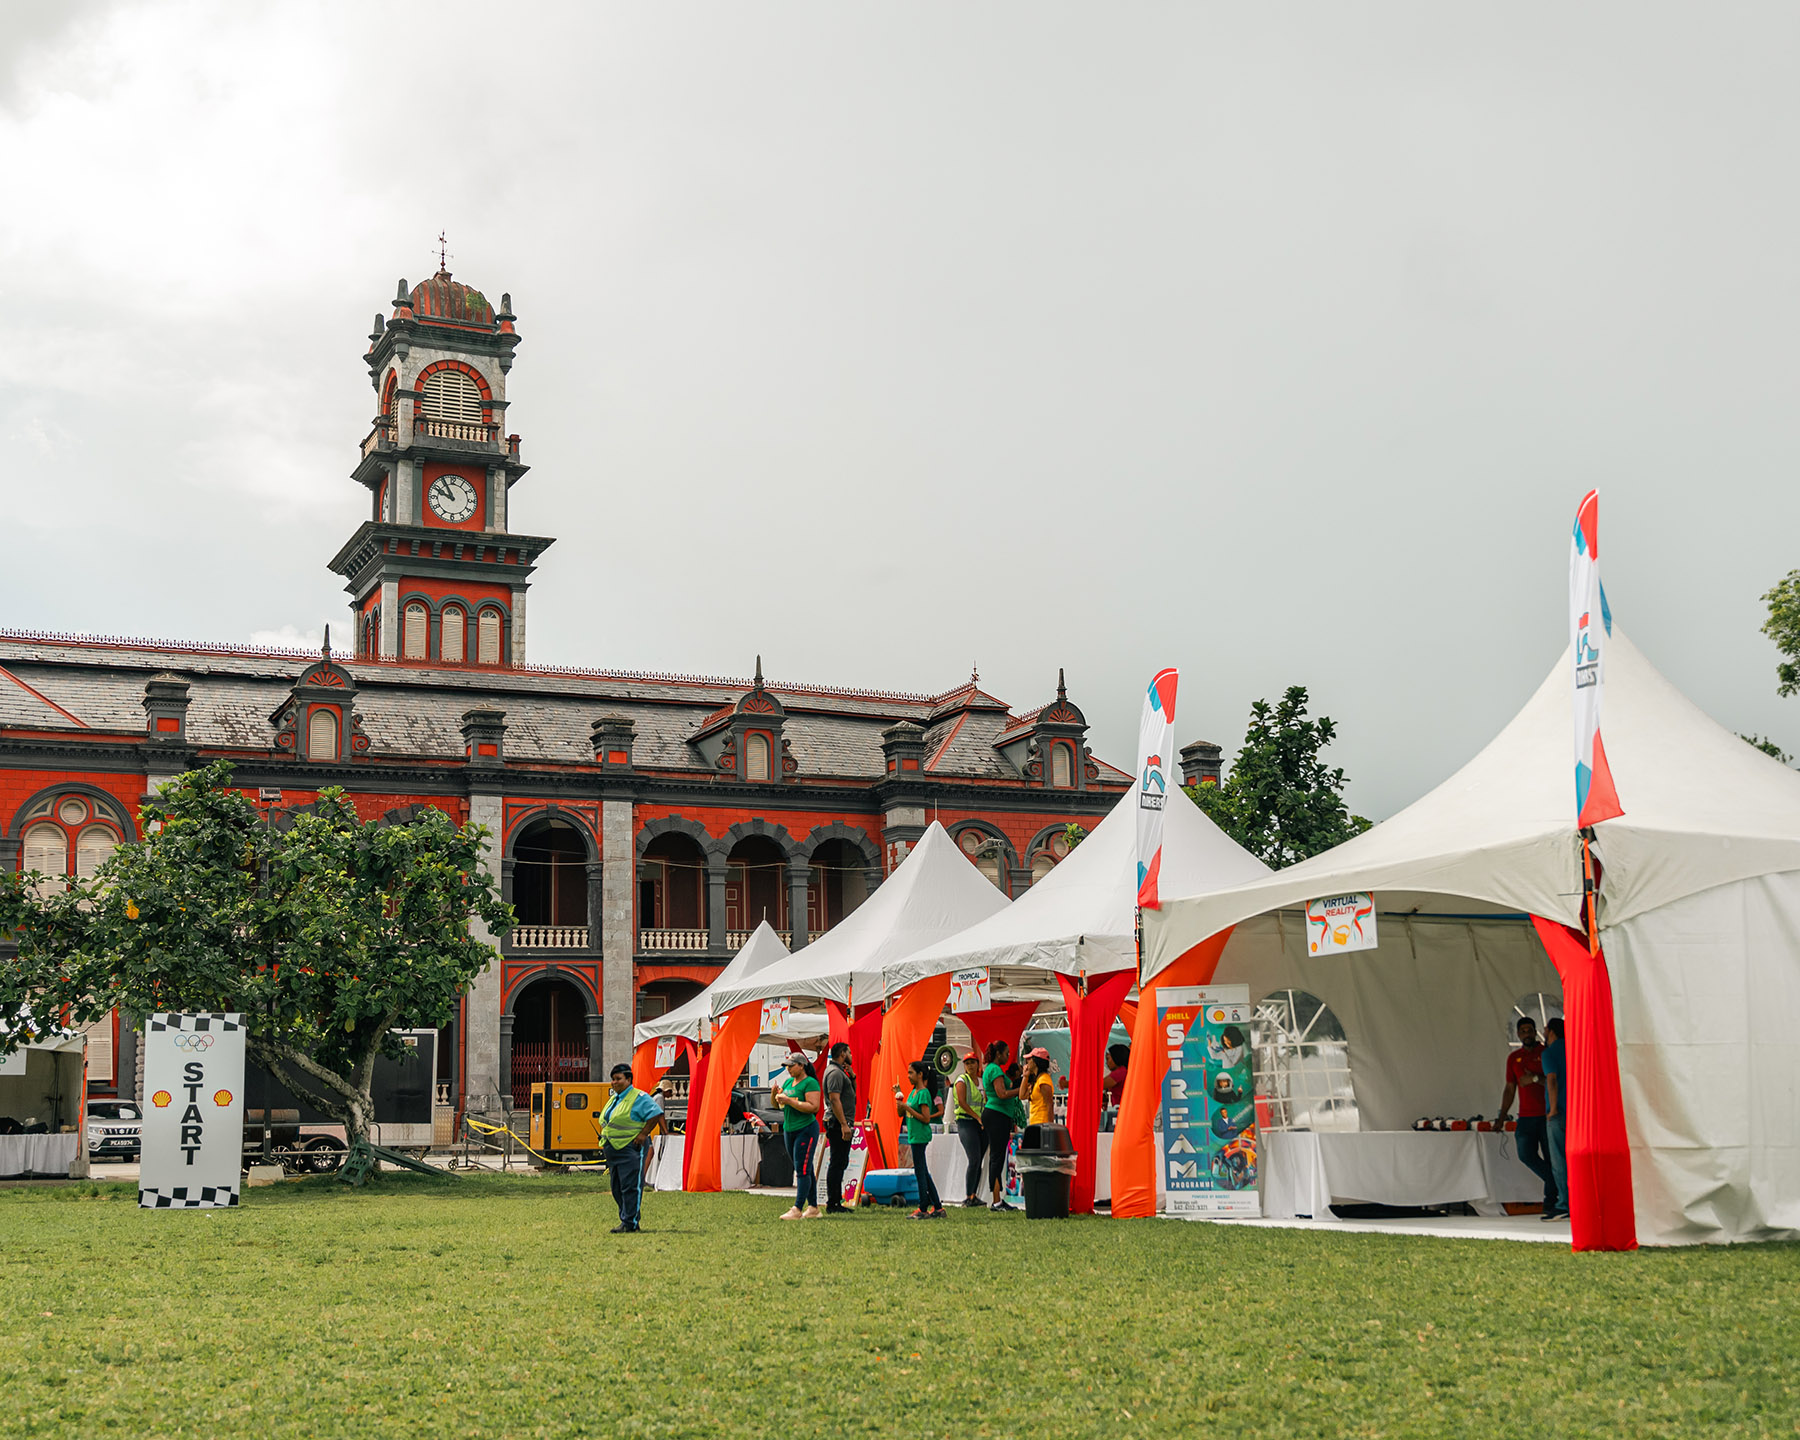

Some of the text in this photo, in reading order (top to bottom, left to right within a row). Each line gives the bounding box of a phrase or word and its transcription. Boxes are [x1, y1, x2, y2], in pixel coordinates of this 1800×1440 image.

[1323, 895, 1358, 908] VIRTUAL
[1326, 905, 1356, 917] REALITY
[959, 972, 980, 980] TROPICAL
[1166, 1023, 1197, 1179] STREAM
[180, 1062, 204, 1165] START
[1171, 1181, 1214, 1189] PROGRAMME
